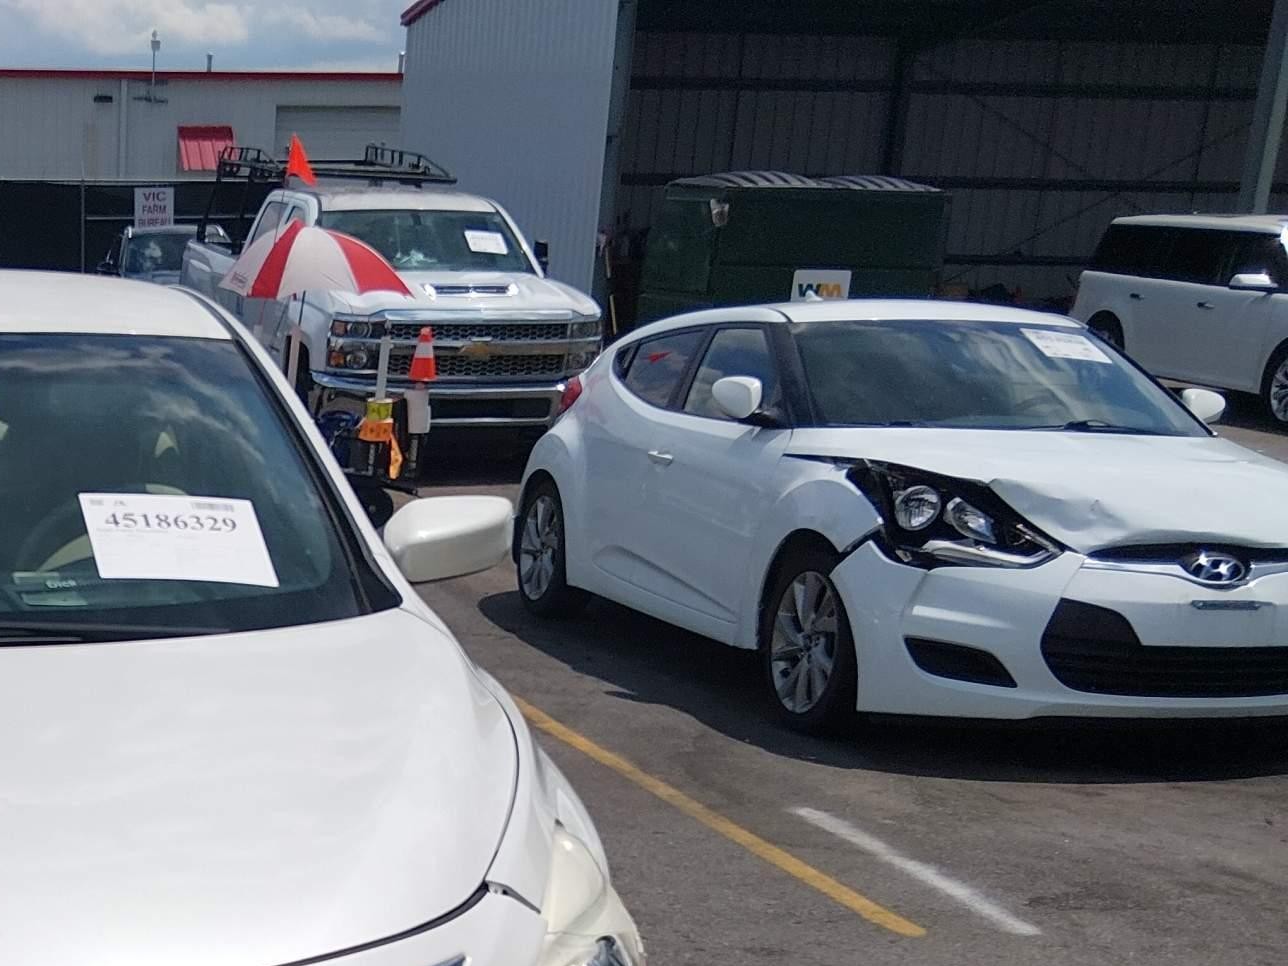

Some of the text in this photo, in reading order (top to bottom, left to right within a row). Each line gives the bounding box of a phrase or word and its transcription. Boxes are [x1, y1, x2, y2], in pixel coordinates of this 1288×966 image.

[143, 191, 167, 201] VIC
[142, 204, 167, 214] FARM
[798, 283, 841, 297] WM
[105, 513, 237, 532] 45186329
